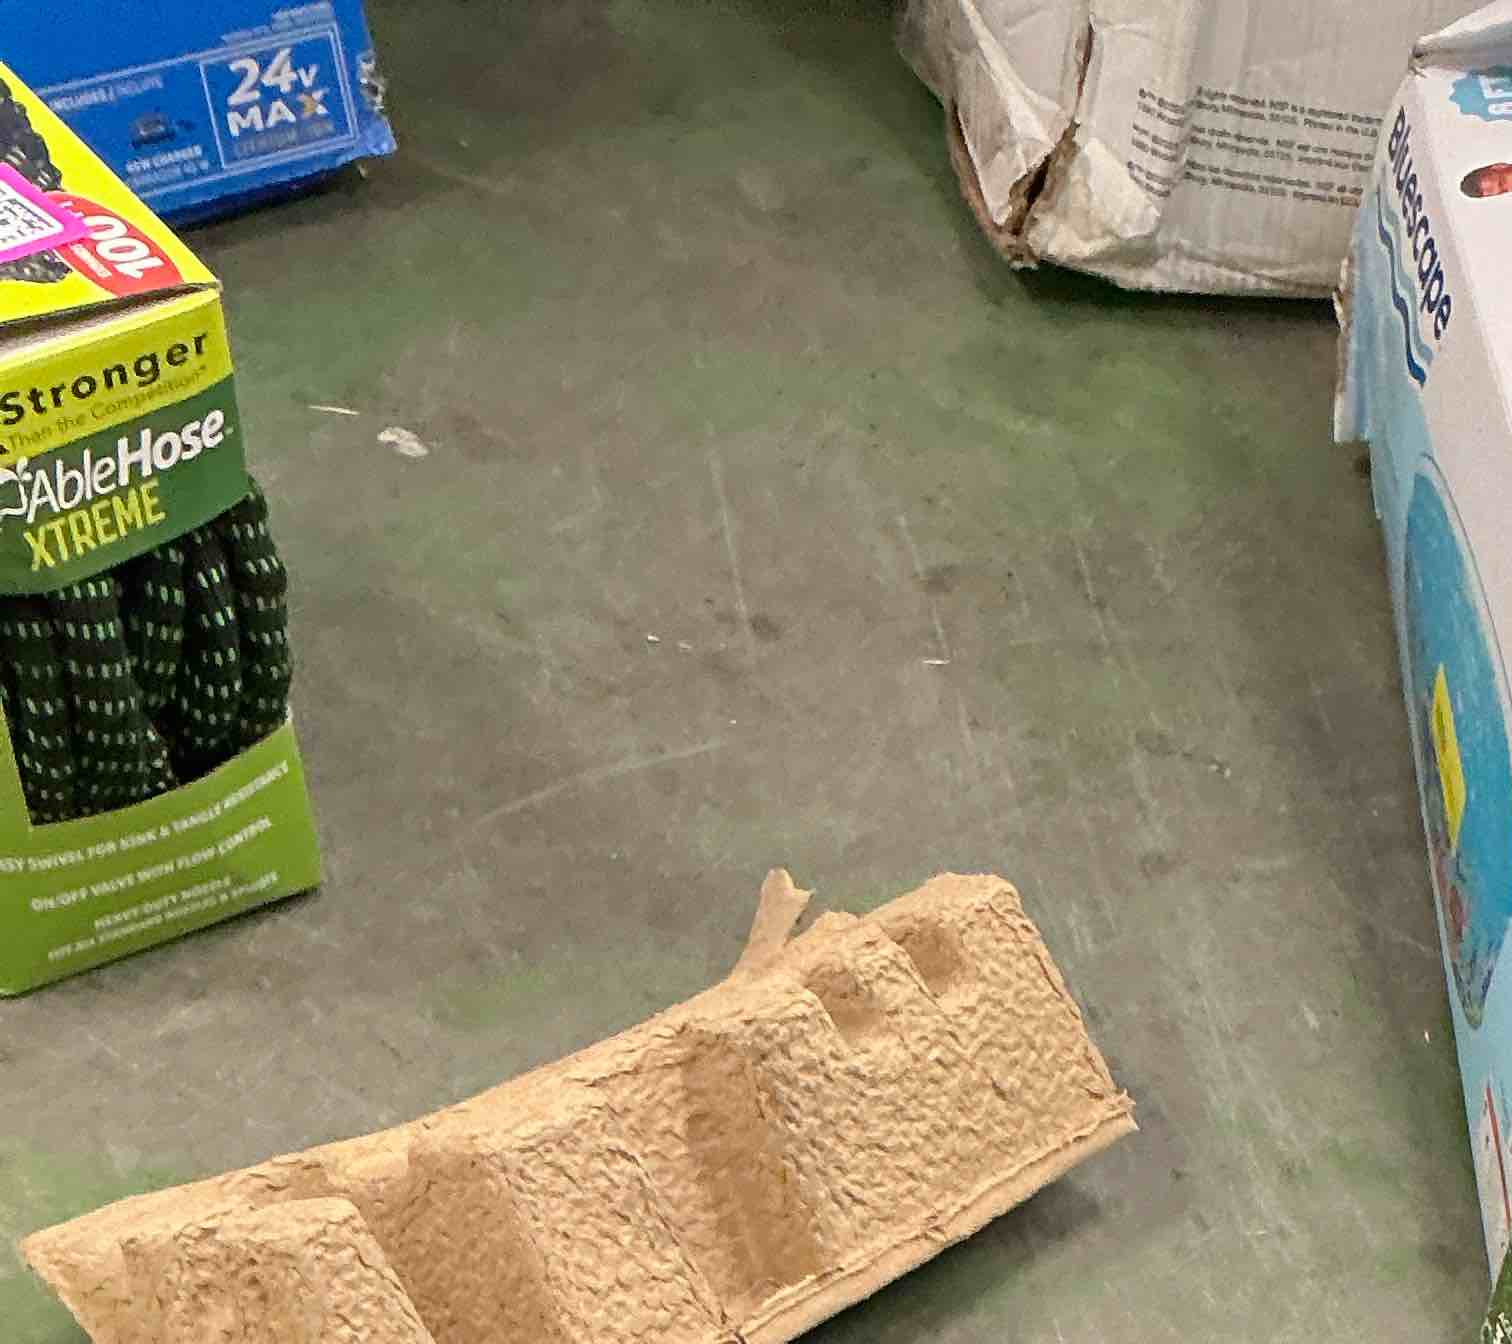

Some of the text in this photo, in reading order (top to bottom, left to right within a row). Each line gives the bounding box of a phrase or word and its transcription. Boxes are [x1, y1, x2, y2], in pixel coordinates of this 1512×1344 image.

[226, 88, 330, 138] MAX
[1388, 106, 1452, 341] Bluescape
[0, 331, 209, 426] Stronger
[26, 409, 225, 524] AbleHose
[23, 478, 167, 573] XTREME
